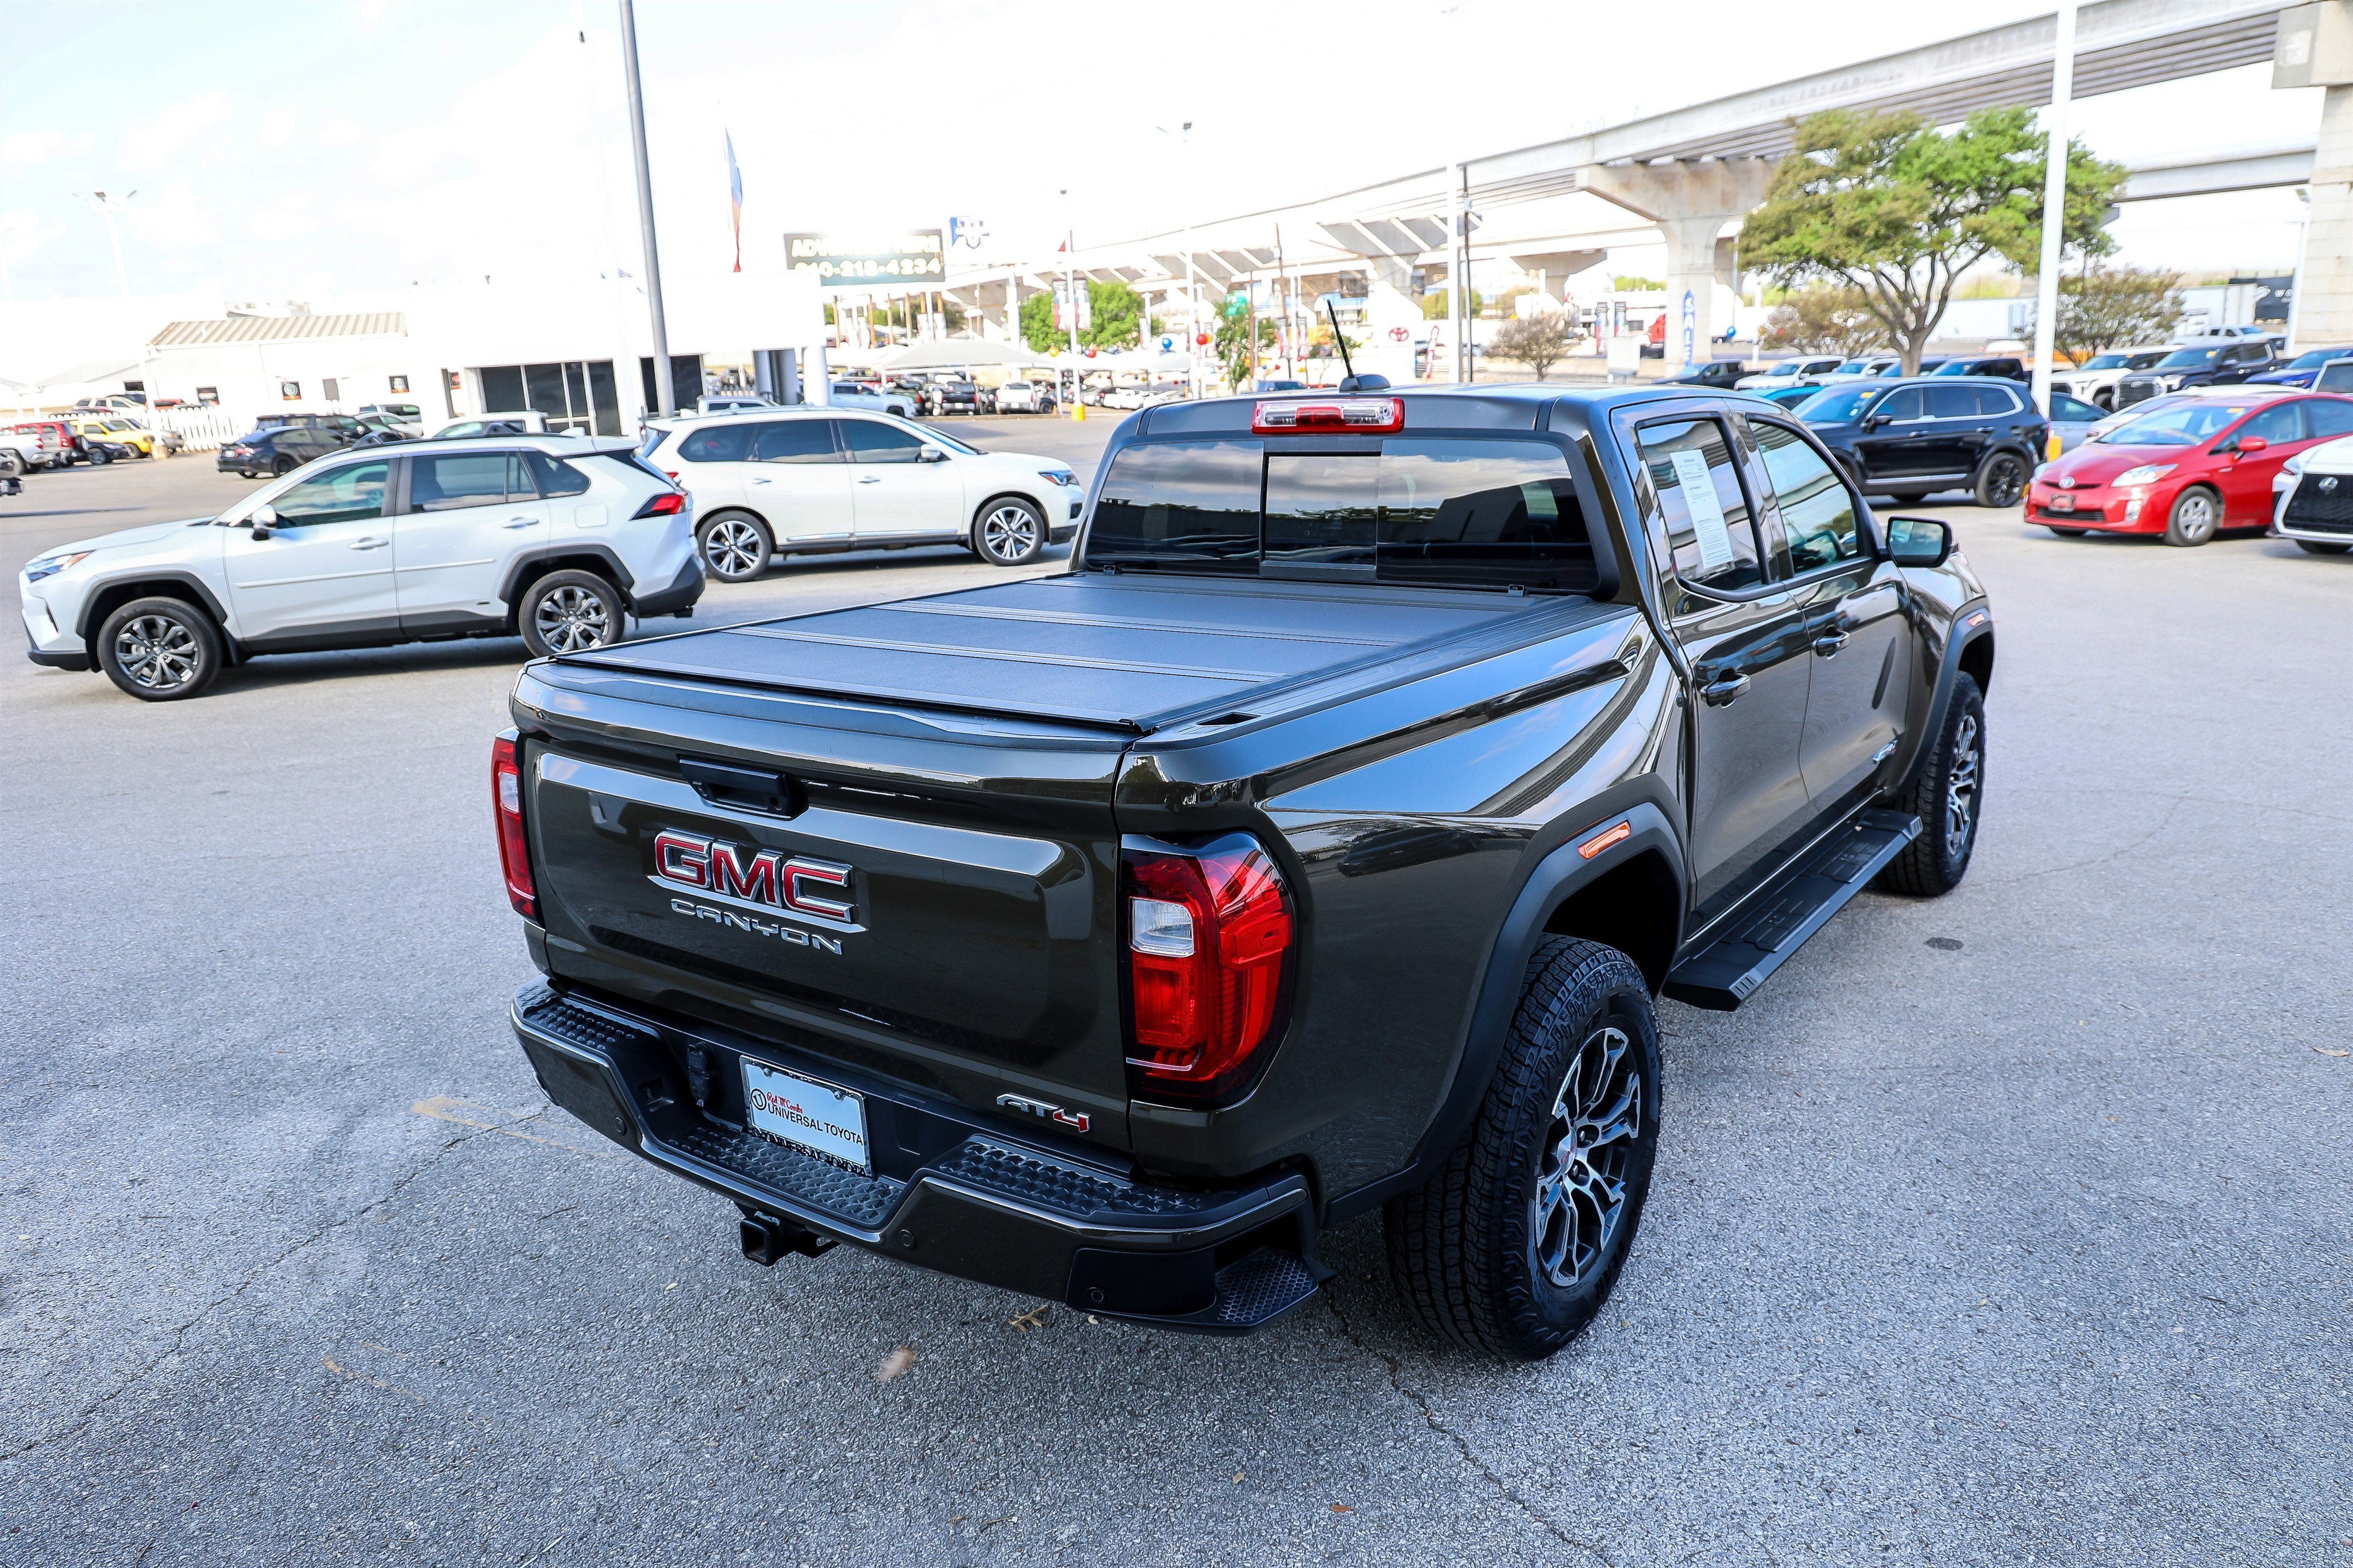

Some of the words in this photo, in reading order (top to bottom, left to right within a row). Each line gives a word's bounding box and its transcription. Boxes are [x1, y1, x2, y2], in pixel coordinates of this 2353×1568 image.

[655, 828, 854, 923] GMC
[671, 898, 843, 955] CANYON
[767, 1092, 778, 1106] Red
[997, 1092, 1090, 1133] AT4
[768, 1103, 823, 1132] UNIVERSAL
[824, 1122, 863, 1146] TOYOTA
[765, 1131, 824, 1162] UNIVERSAL
[825, 1154, 867, 1176] TOYOTA
